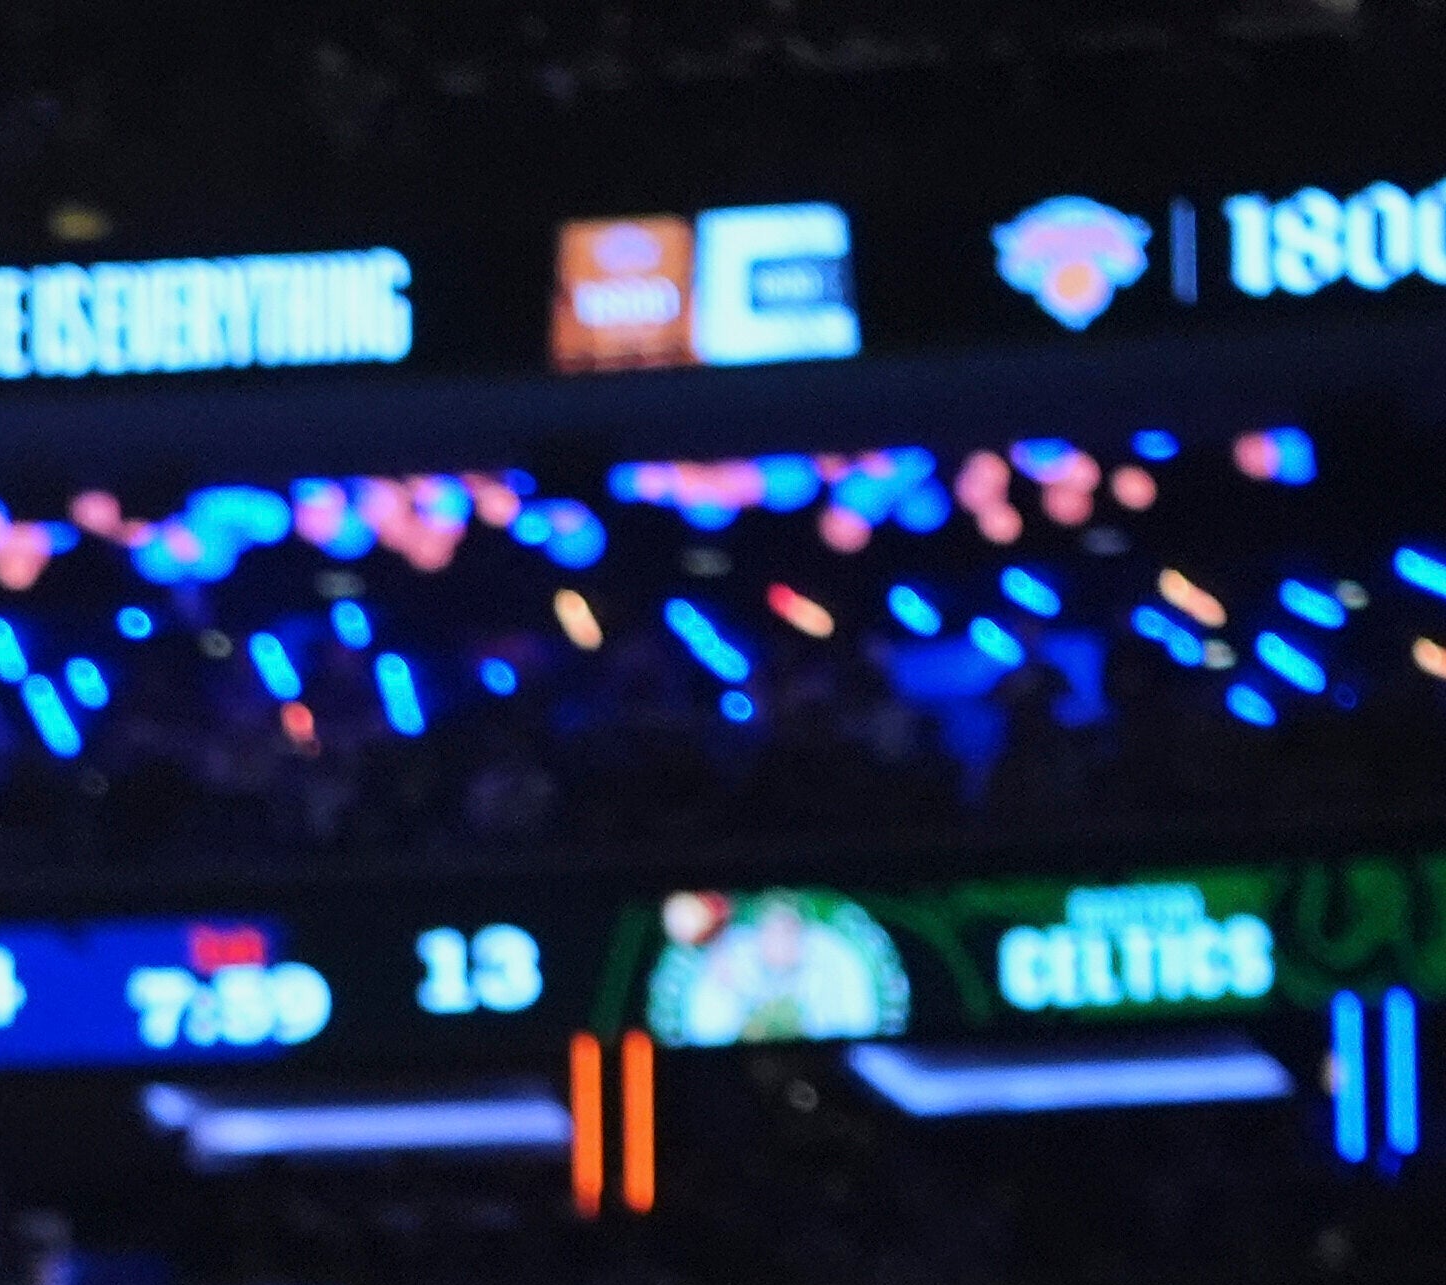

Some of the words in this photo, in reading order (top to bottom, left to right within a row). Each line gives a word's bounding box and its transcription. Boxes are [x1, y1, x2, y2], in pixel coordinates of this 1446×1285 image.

[32, 263, 92, 379] IS
[90, 247, 412, 373] EVERYTHING
[415, 922, 543, 1014] 13
[997, 914, 1275, 1011] CELTICS
